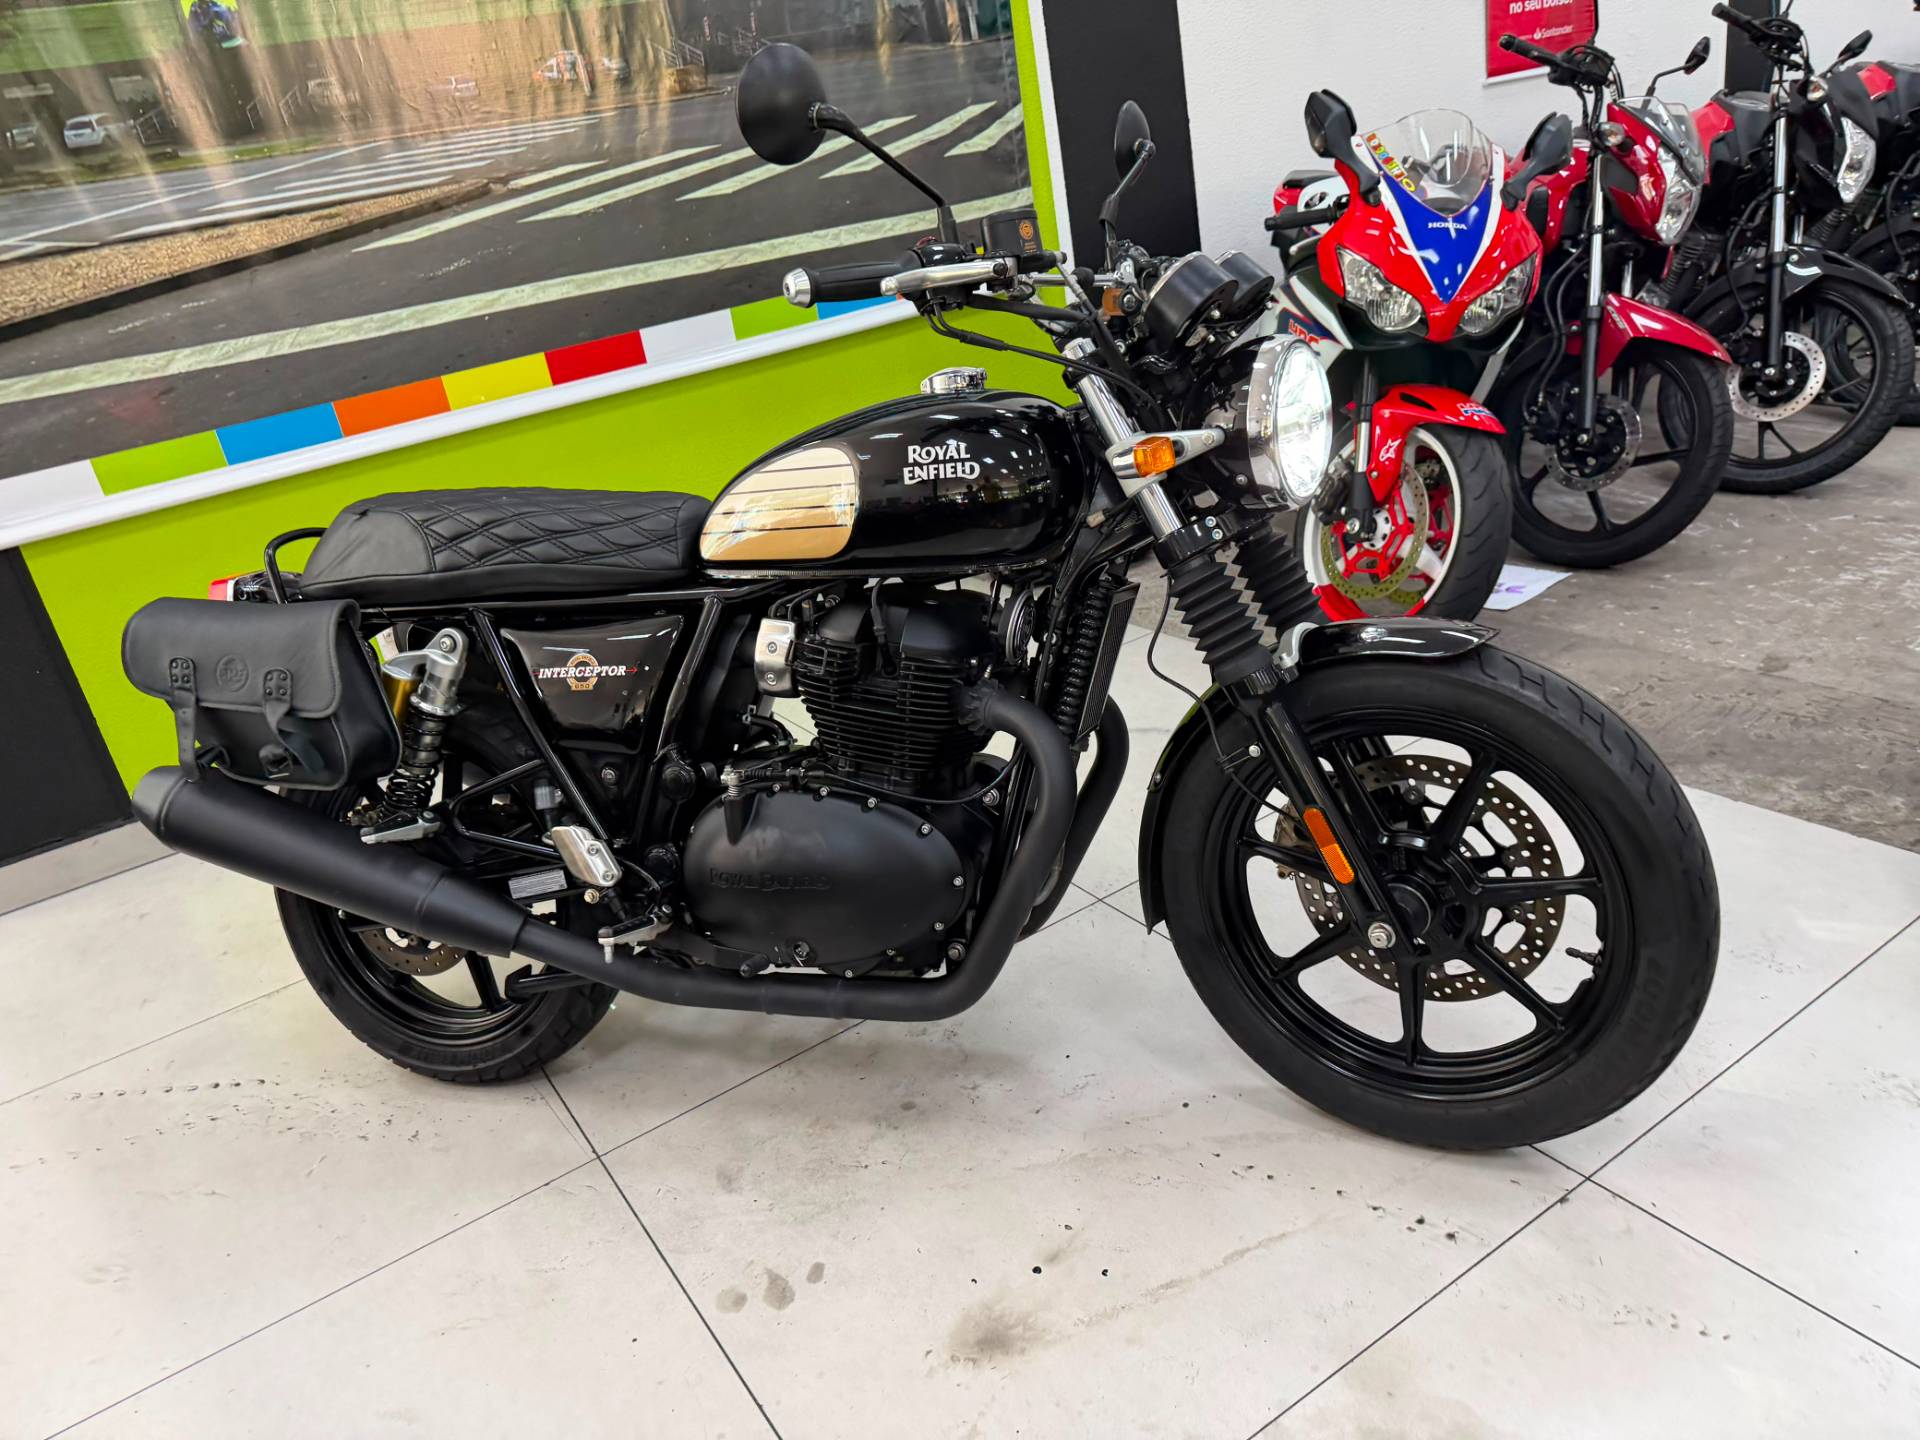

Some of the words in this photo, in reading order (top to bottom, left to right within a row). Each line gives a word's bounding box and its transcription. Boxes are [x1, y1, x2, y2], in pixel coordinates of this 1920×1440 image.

[1509, 2, 1523, 14] no
[1524, 0, 1542, 11] seu
[1541, 25, 1573, 38] Santander
[1427, 221, 1468, 230] HONDA
[907, 442, 971, 464] ROYAL
[903, 461, 981, 485] ENFIELD
[538, 665, 627, 679] INTERCEPTOR
